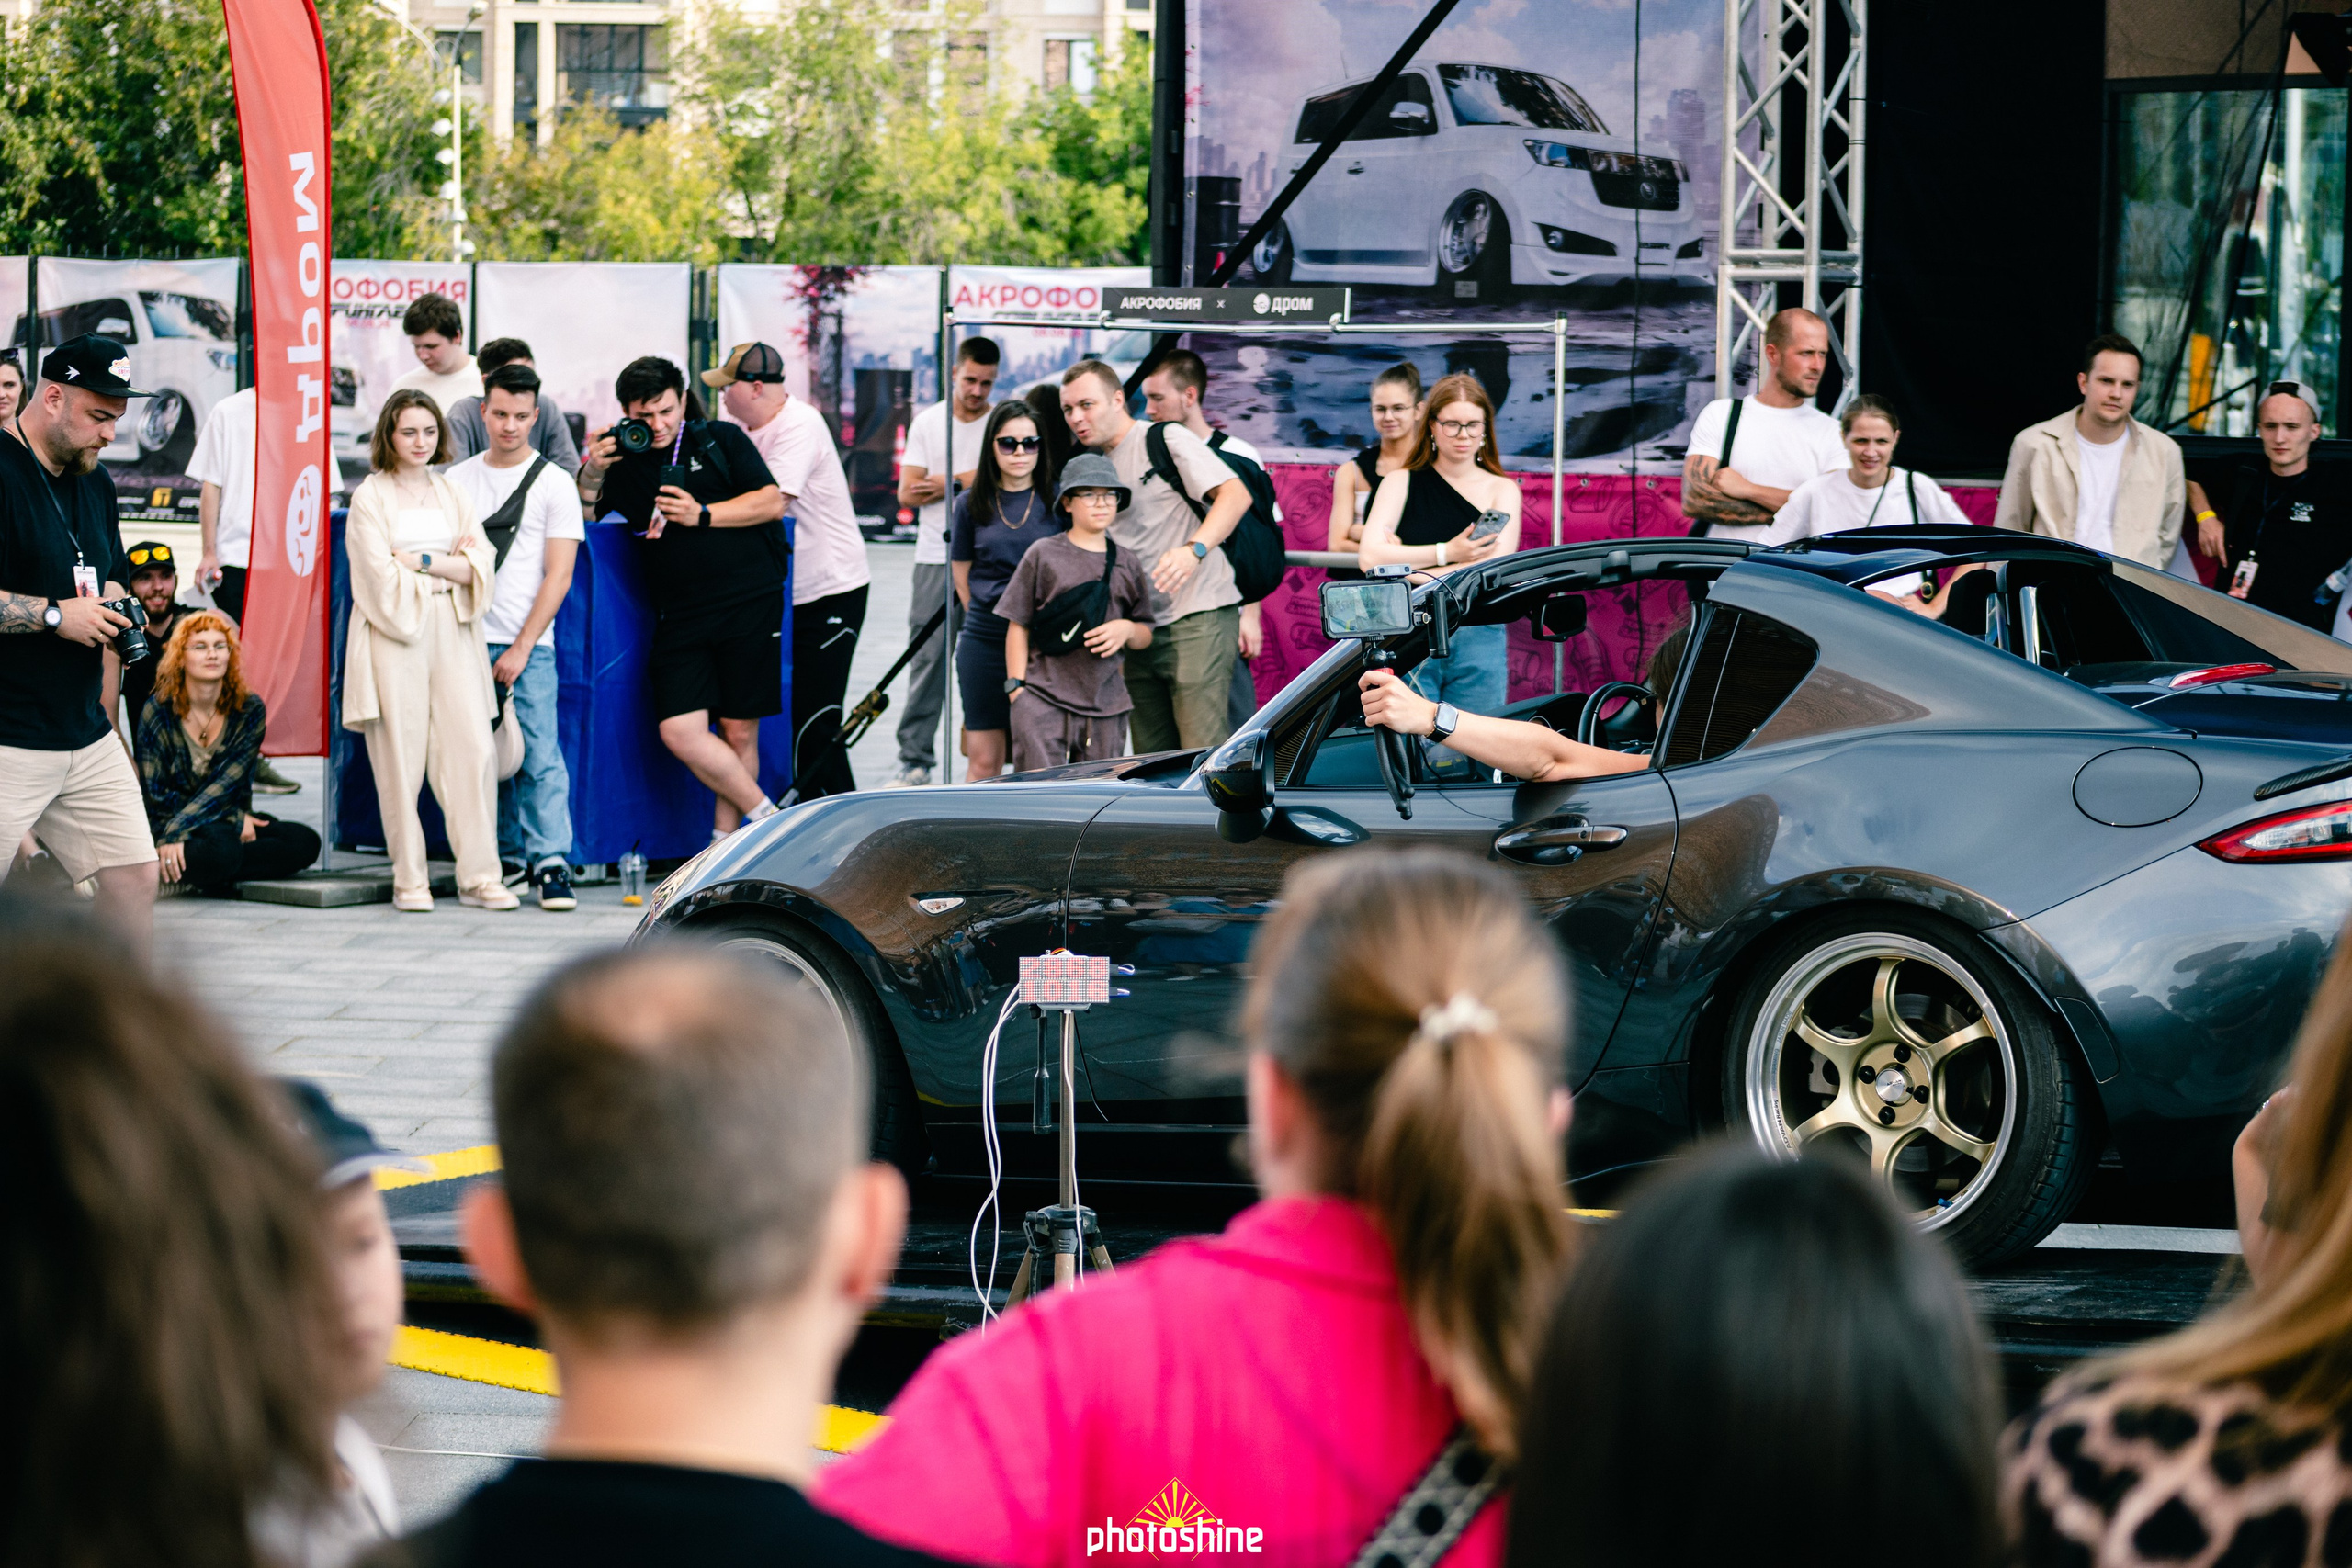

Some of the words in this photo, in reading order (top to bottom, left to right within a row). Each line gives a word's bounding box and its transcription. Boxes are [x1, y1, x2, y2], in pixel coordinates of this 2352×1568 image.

[334, 277, 467, 301] ОФОБИЯ
[954, 285, 1098, 309] АКРОФО
[1120, 296, 1203, 310] АКРОФОБИЯ
[1021, 956, 1108, 979] 2868
[1023, 979, 1108, 1001] 1016
